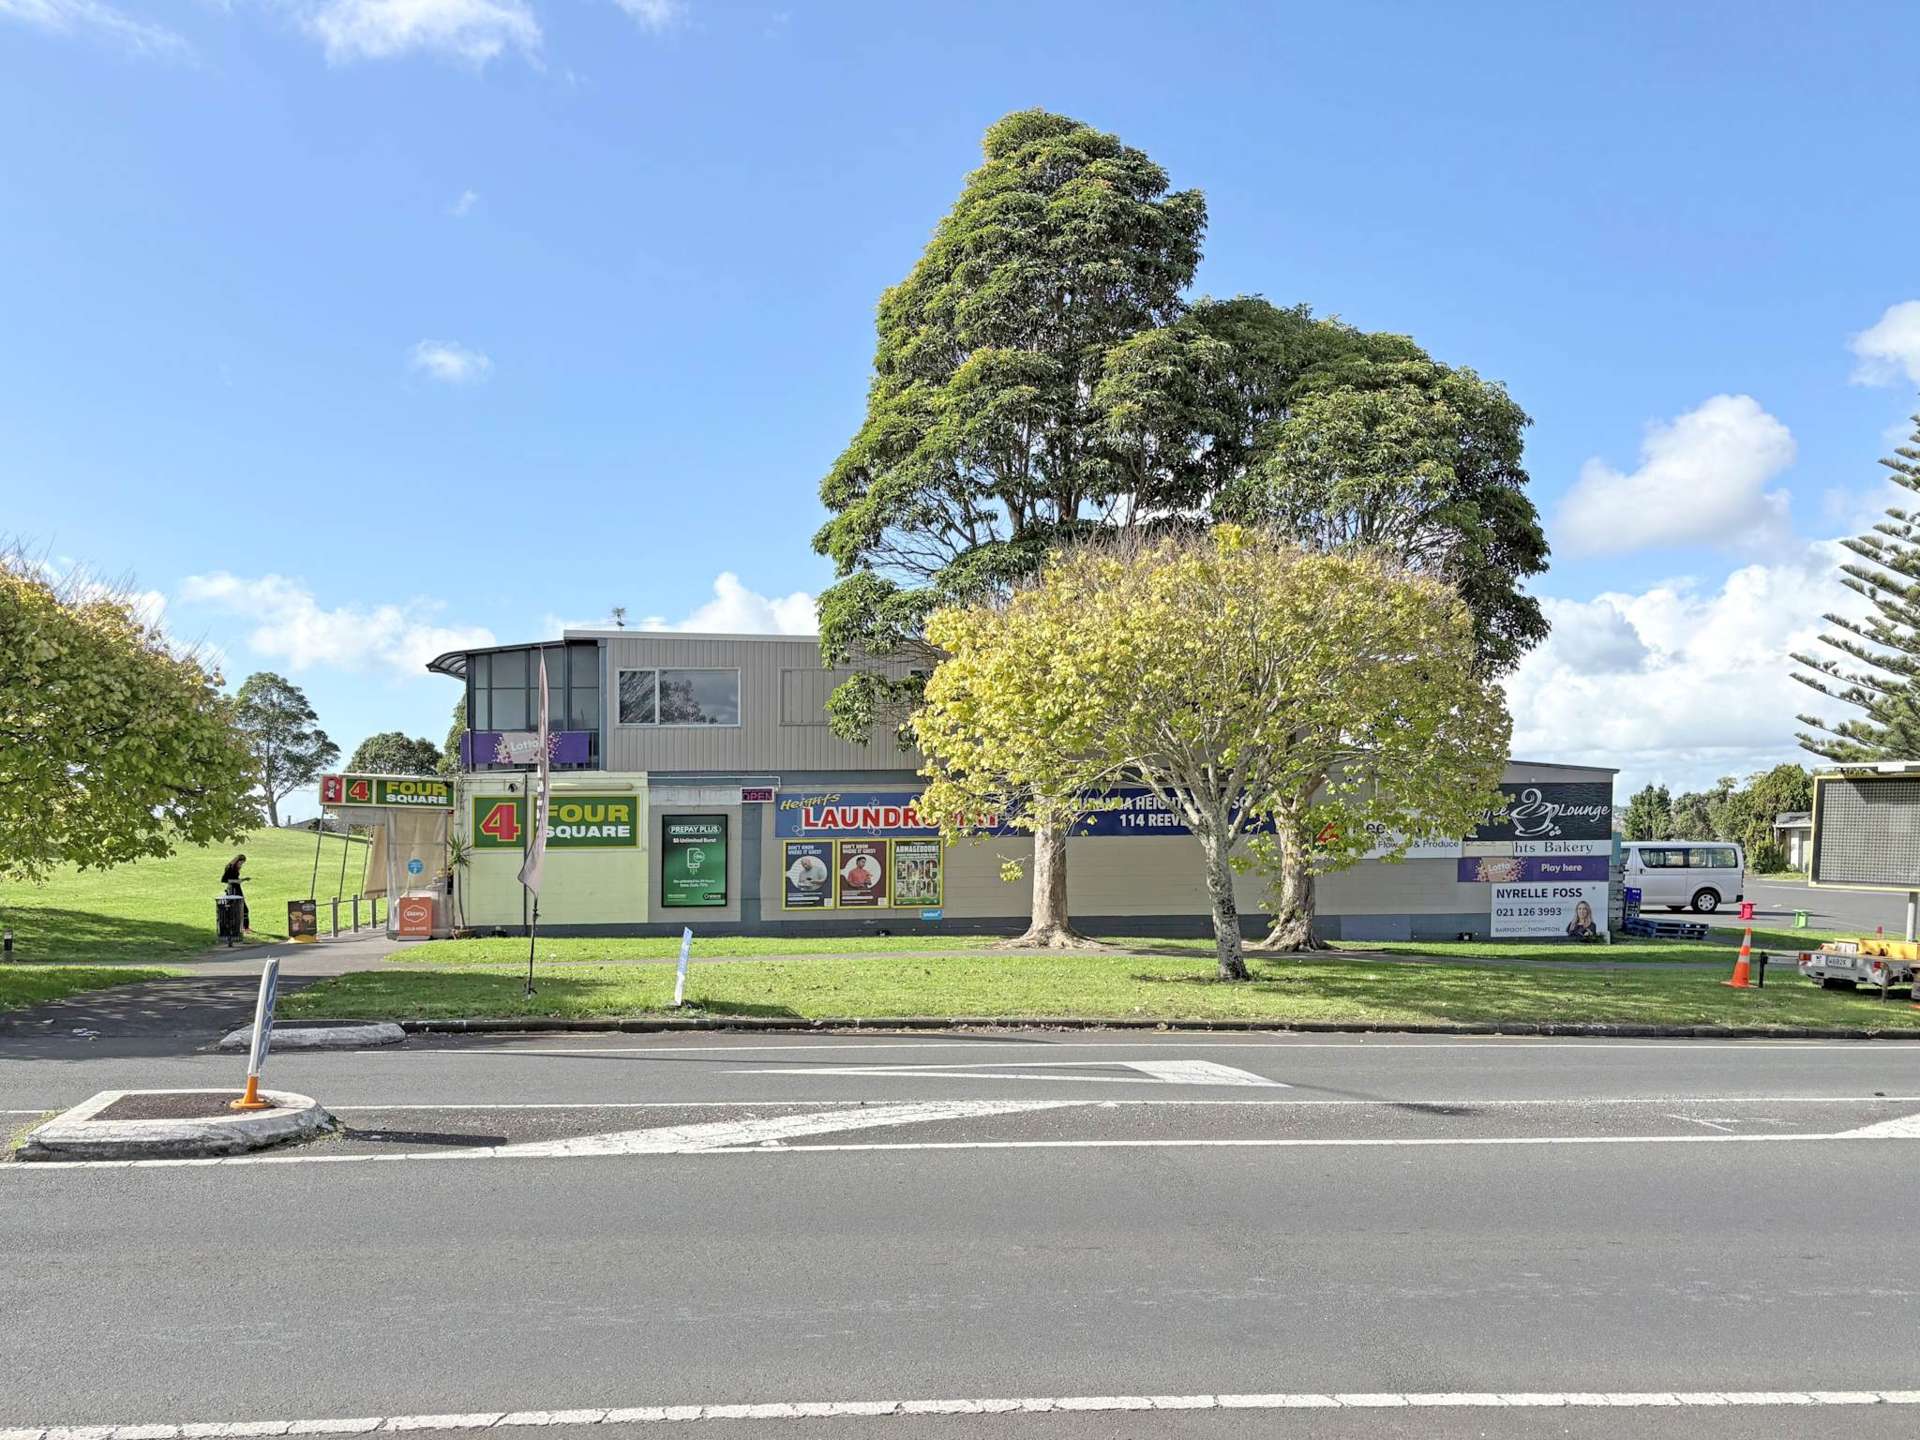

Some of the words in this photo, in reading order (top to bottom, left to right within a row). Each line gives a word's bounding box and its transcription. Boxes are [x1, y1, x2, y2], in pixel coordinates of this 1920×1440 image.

[511, 740, 539, 752] Lotto
[348, 780, 369, 801] 4
[386, 781, 448, 795] FOUR
[386, 794, 448, 804] SQUARE
[743, 792, 772, 800] OPEN
[1559, 804, 1610, 822] Lounge
[479, 802, 521, 842] 4
[1120, 814, 1145, 827] 114
[700, 825, 719, 833] PLUS
[1413, 840, 1421, 848] &
[1422, 840, 1459, 848] Produce
[1544, 842, 1594, 855] Bakery
[1487, 863, 1510, 872] Lotto
[1541, 864, 1562, 873] Play
[1563, 863, 1583, 872] here
[1496, 888, 1548, 899] NYRELLE
[1552, 887, 1583, 898] FOSS
[1496, 908, 1515, 917] 021
[1518, 907, 1536, 917] 126
[1537, 907, 1562, 916] 3993
